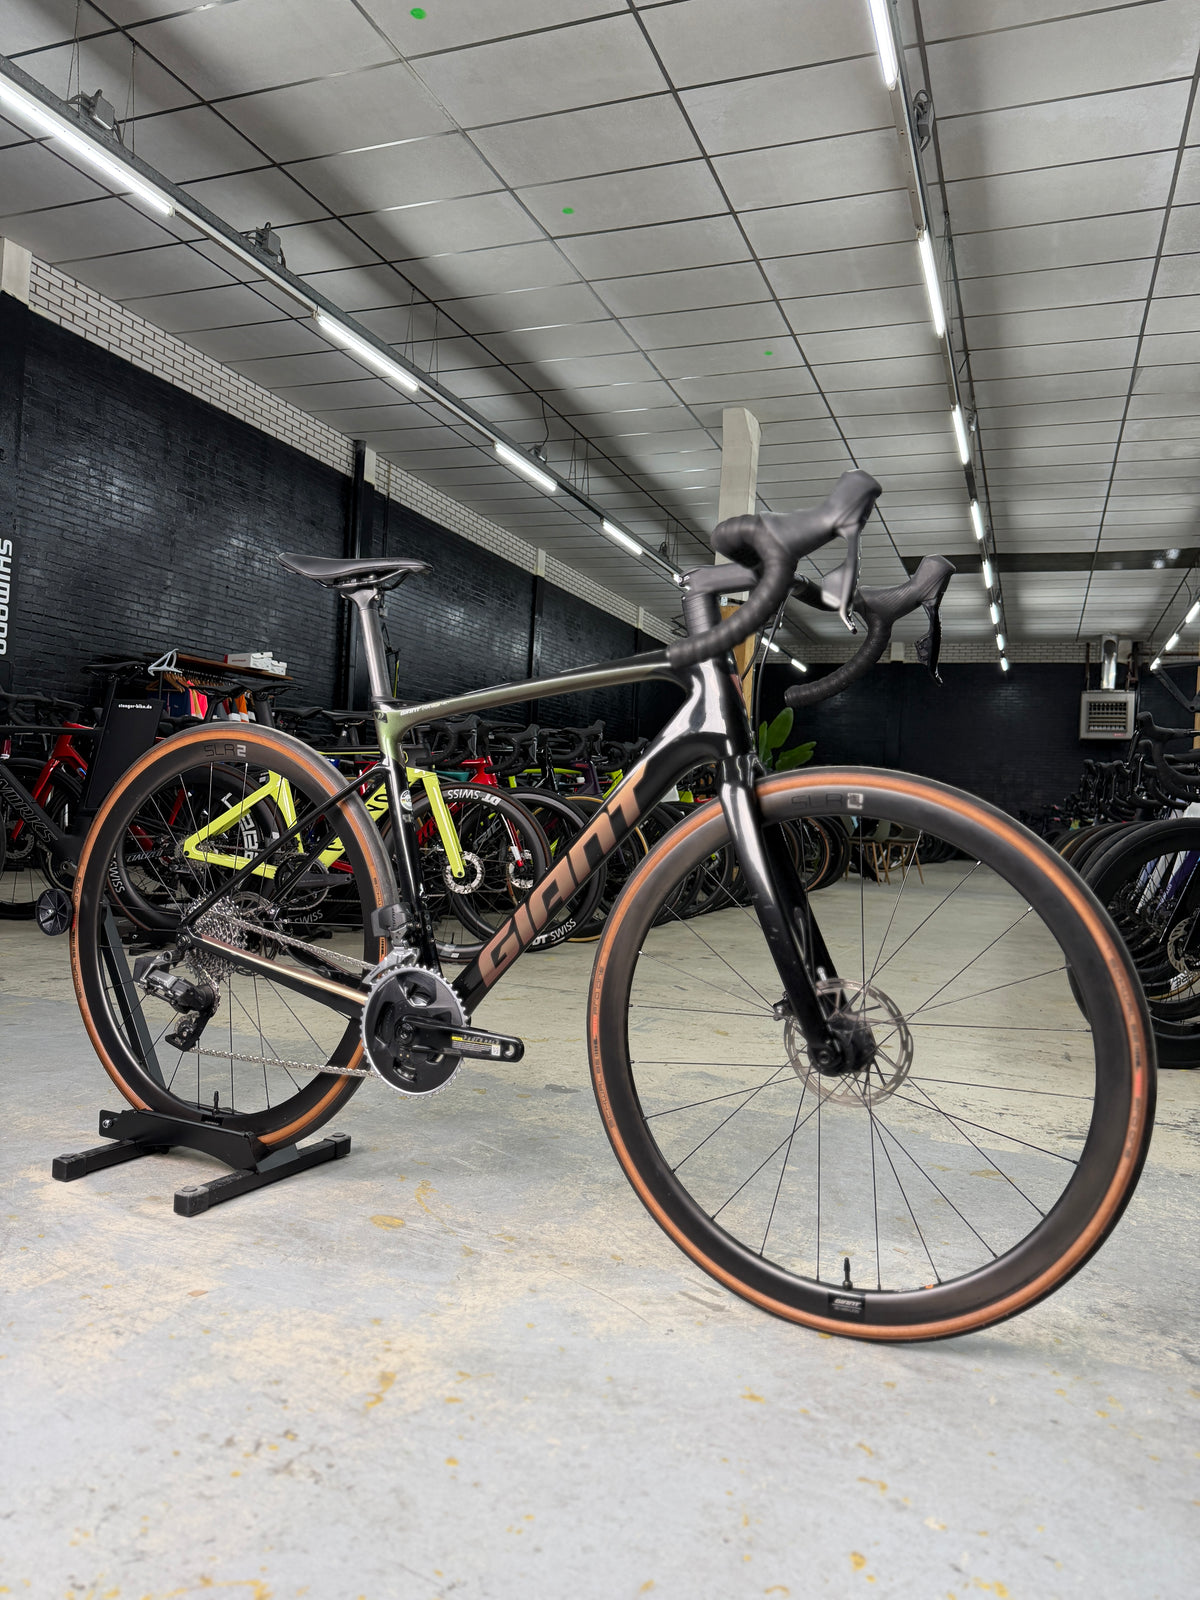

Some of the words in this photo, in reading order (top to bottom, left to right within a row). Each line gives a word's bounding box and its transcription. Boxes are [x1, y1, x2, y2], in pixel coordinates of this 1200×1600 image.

[447, 789, 481, 801] SWISS
[481, 793, 502, 807] DT
[479, 762, 646, 988] GIANT
[532, 934, 548, 946] DT
[550, 918, 577, 941] SWISS
